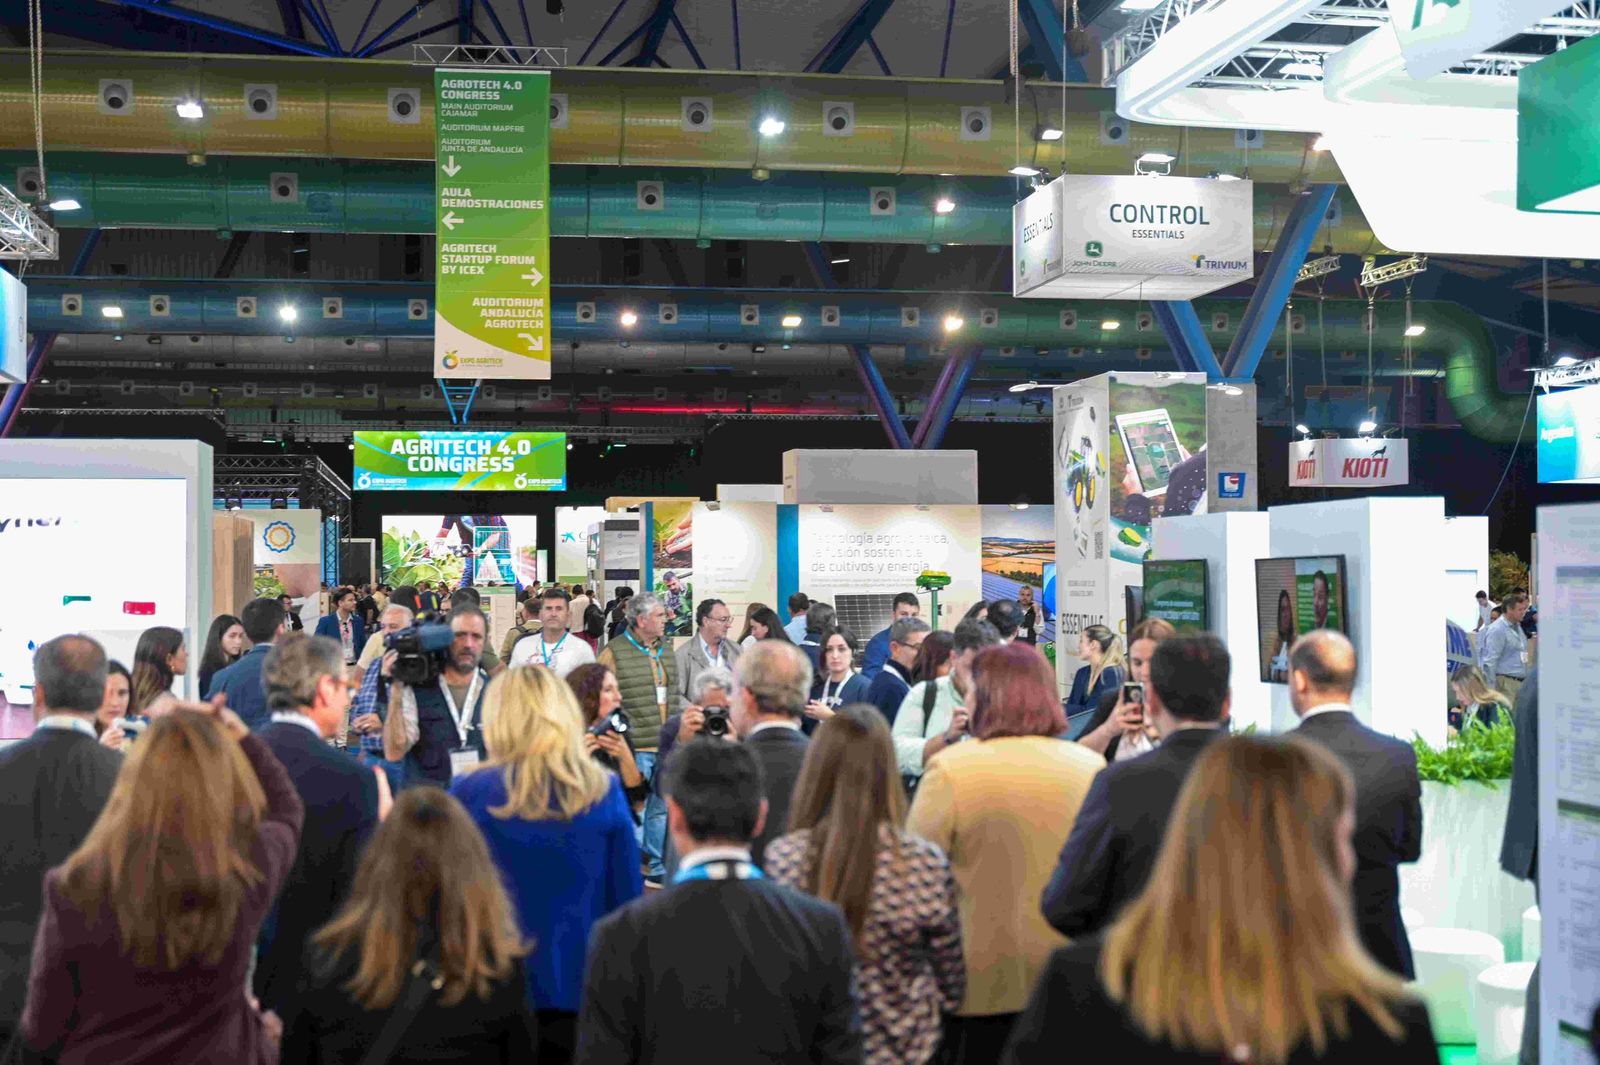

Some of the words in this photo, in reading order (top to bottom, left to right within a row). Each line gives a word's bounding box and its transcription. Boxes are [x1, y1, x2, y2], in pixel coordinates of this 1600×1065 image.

[441, 79, 500, 89] AGROTECH
[503, 81, 522, 90] 4.0
[441, 90, 500, 100] CONGRESS
[463, 103, 513, 111] AUDITORIUM
[441, 124, 491, 132] AUDITORIUM
[441, 187, 472, 197] AULA
[441, 198, 544, 209] DEMOSTRACIONES
[1110, 203, 1210, 225] CONTROL
[1132, 229, 1185, 240] ESSENTIALS
[441, 243, 497, 253] AGRITECH
[441, 254, 493, 264] STARTUP
[495, 255, 536, 265] FORUM
[1205, 260, 1247, 270] TRIVIUM
[441, 265, 456, 274] BY
[459, 265, 485, 275] ICEX
[472, 297, 544, 307] AUDITORIUM
[480, 306, 544, 318] ANDALUCÍA
[484, 319, 544, 329] AGROTECH
[390, 438, 492, 456] AGRITECH
[496, 439, 531, 456] 4.0
[407, 456, 515, 473] CONGRESS
[1296, 459, 1316, 480] KIOTI
[1341, 458, 1389, 478] KIOTI
[811, 561, 826, 572] de
[829, 561, 874, 572] cultivos
[877, 563, 885, 574] y
[887, 561, 930, 574] energía
